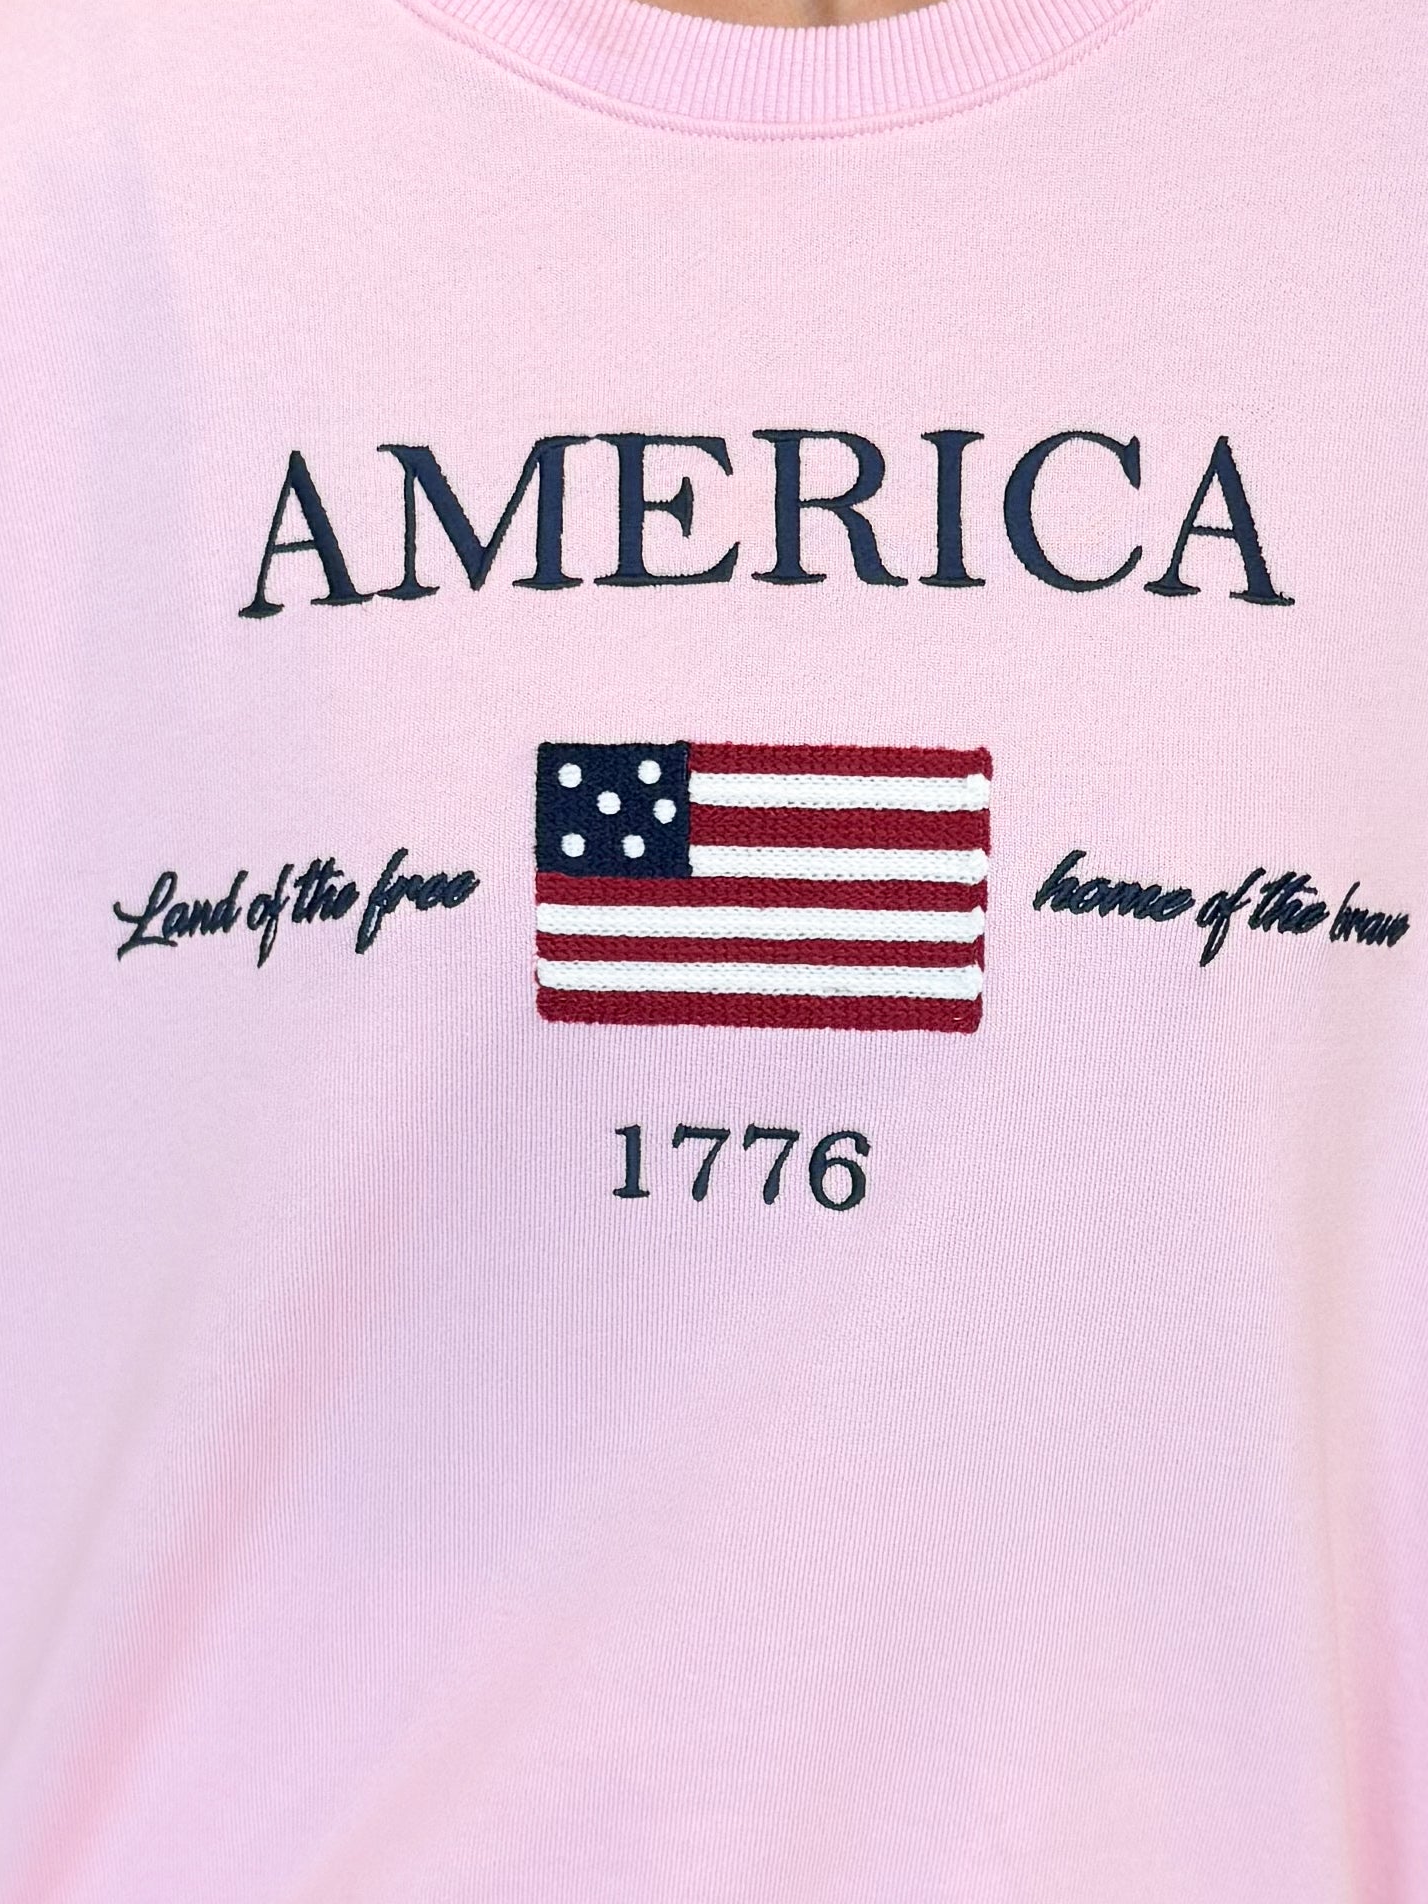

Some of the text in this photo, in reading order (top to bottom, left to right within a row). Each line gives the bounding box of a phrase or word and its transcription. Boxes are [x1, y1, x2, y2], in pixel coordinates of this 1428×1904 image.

[237, 428, 1296, 621] AMERICA
[112, 846, 481, 969] Land of the free
[1032, 849, 1197, 923] home
[1194, 866, 1267, 968] of
[1247, 870, 1331, 936] the
[612, 1122, 872, 1212] 1776
